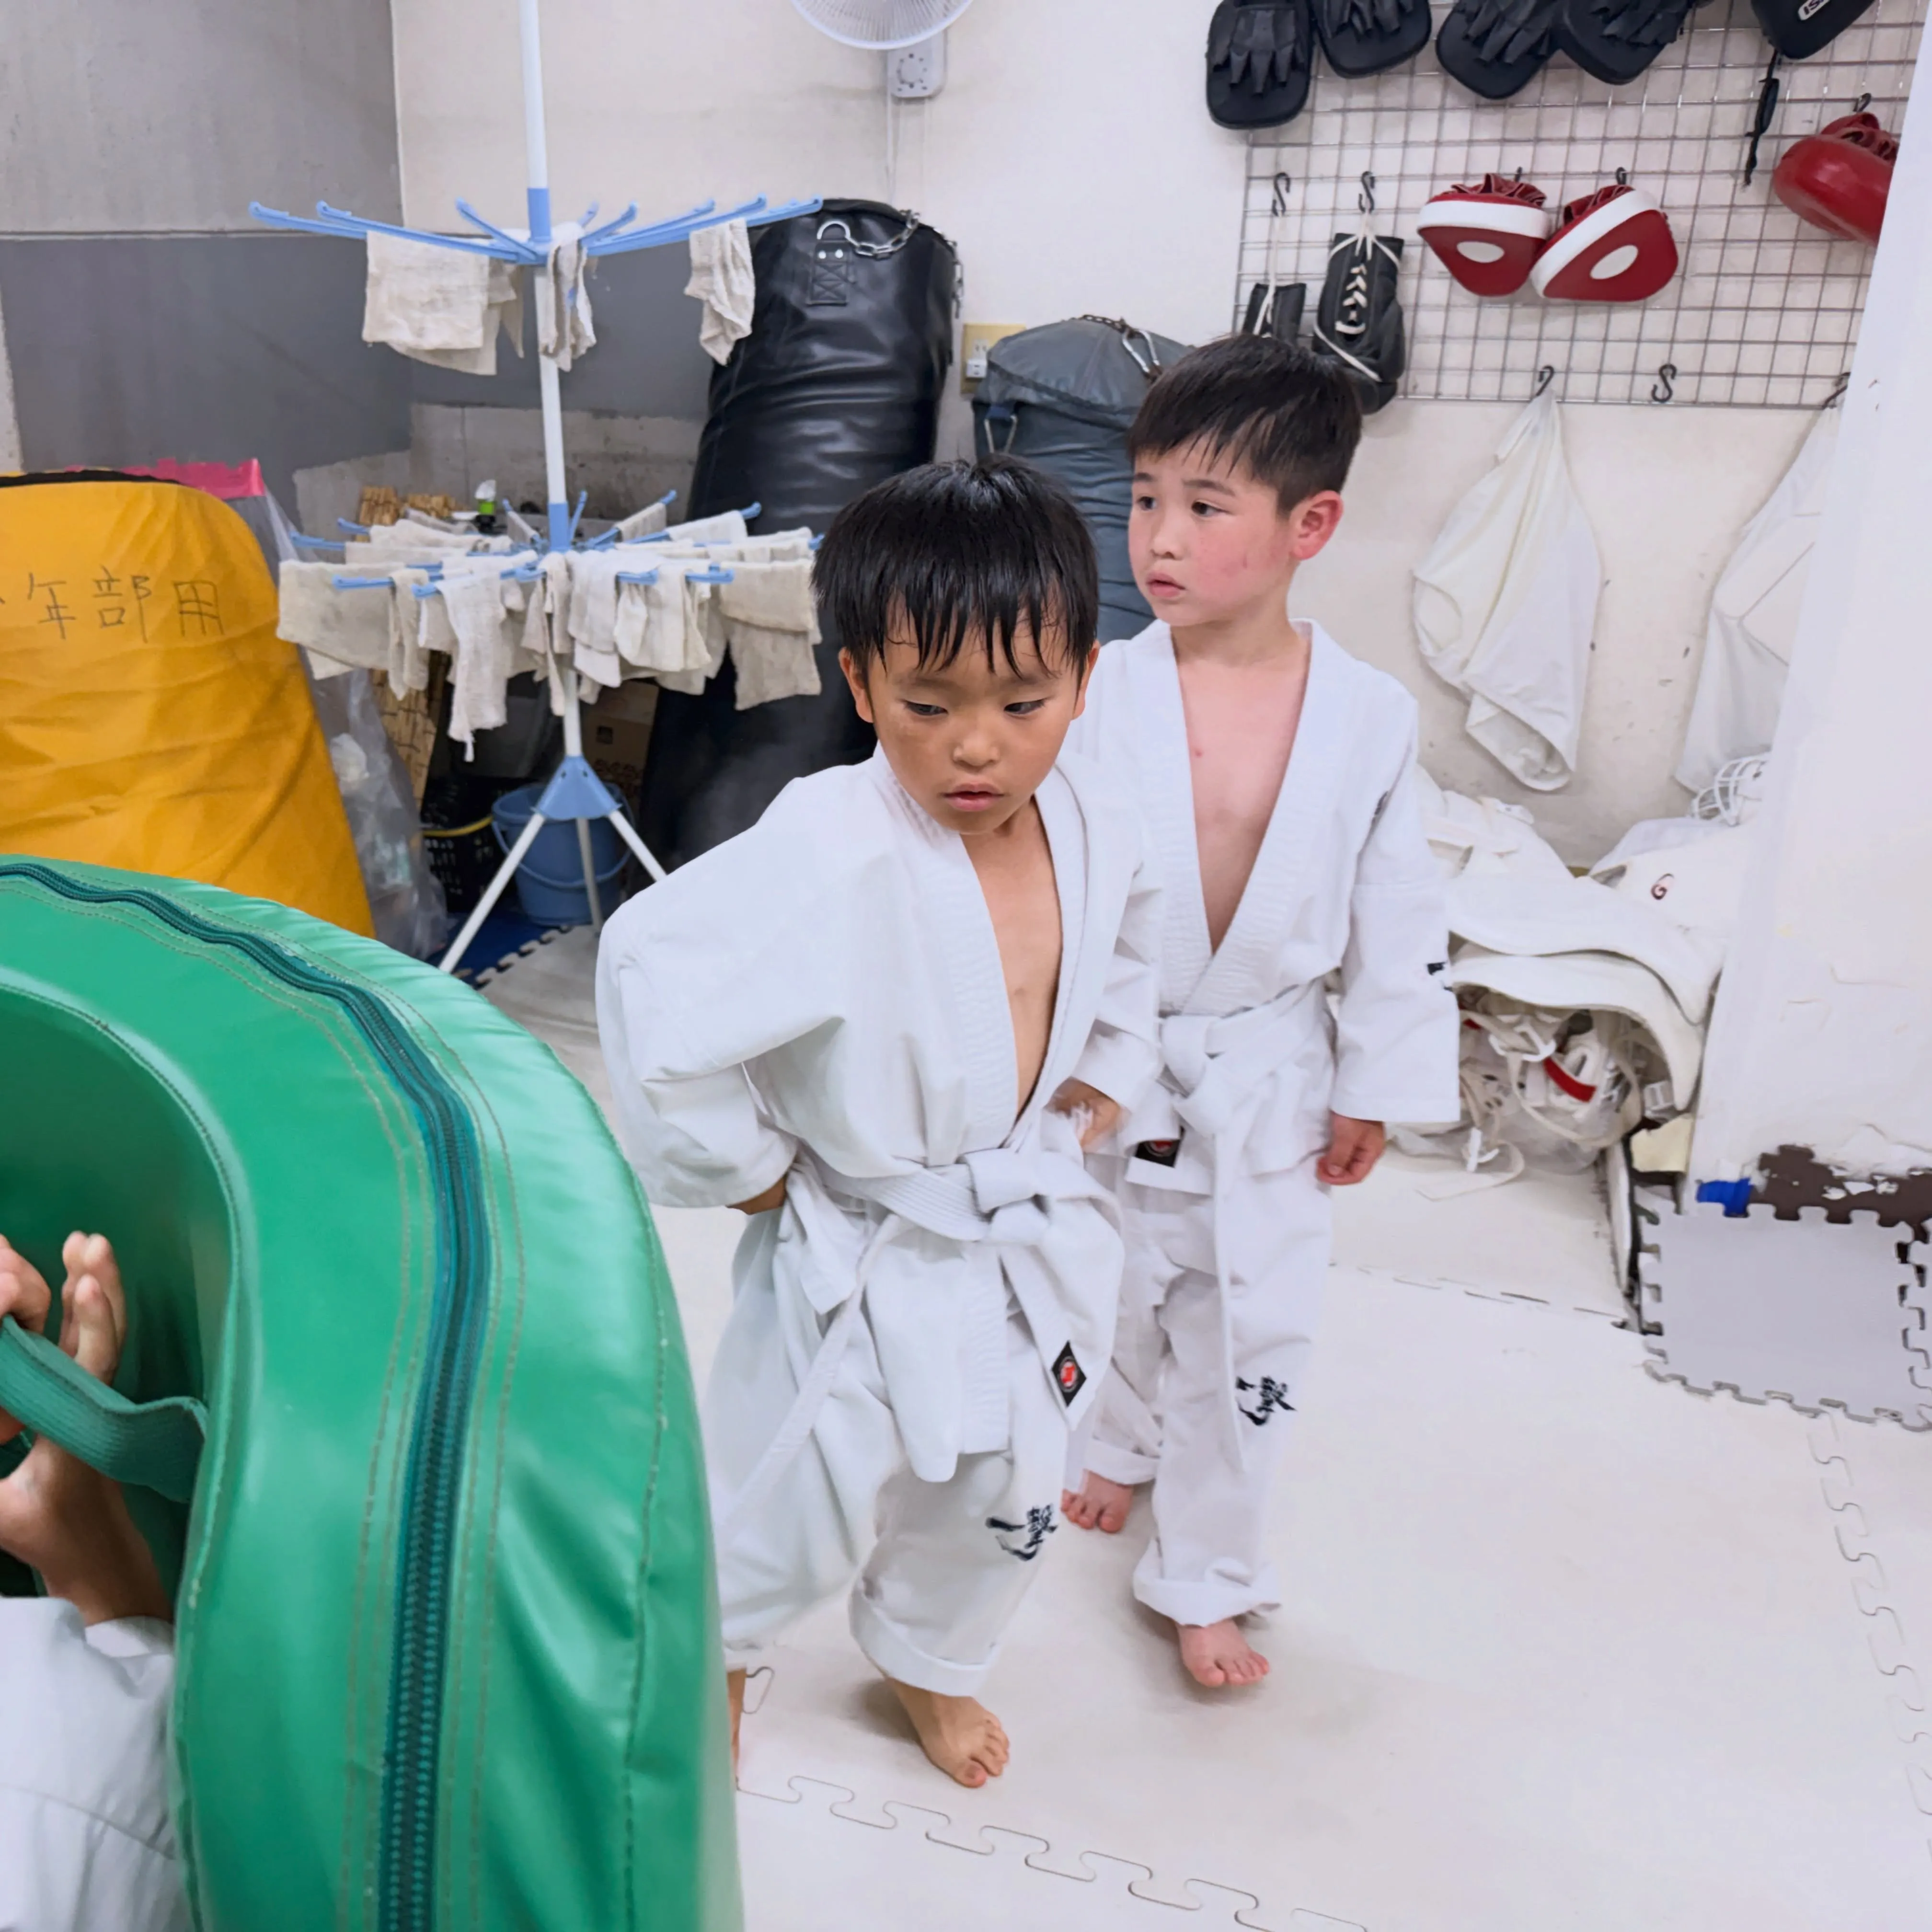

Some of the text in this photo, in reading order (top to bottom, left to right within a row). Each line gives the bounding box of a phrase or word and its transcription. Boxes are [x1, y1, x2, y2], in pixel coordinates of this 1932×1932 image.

[1803, 0, 1824, 15] IS
[0, 565, 225, 644] 年部用
